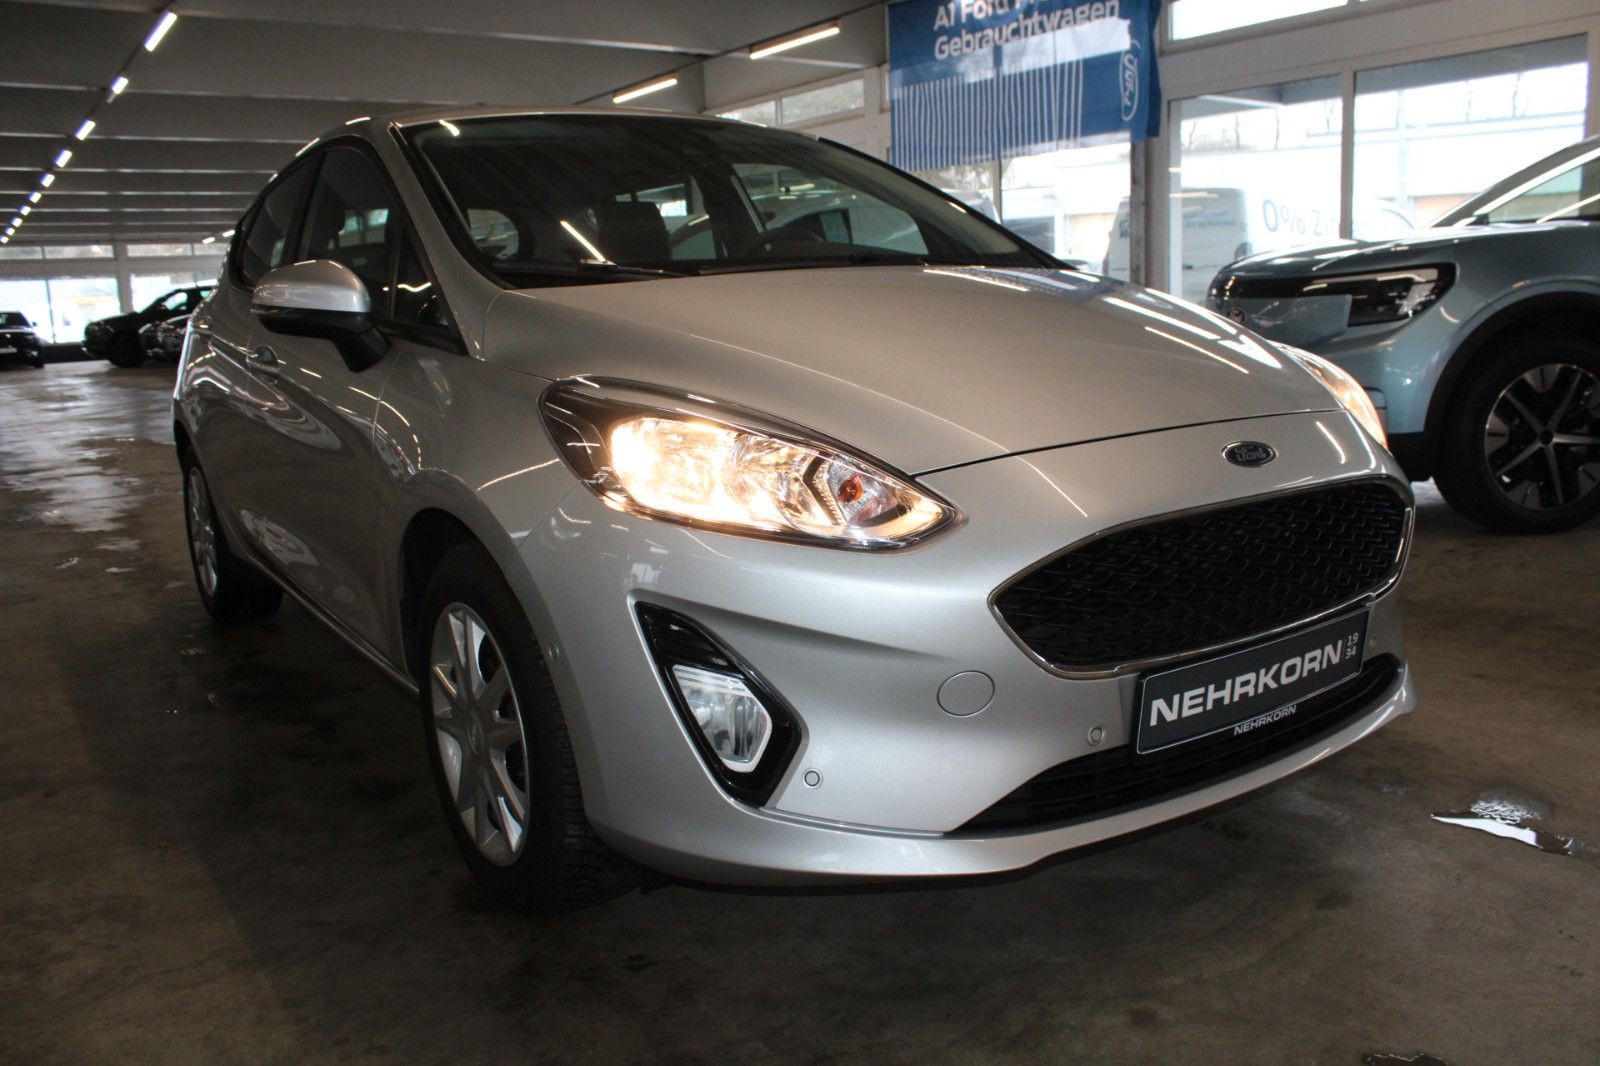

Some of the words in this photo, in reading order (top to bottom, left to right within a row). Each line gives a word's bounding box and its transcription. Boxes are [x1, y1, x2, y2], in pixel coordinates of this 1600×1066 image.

[961, 0, 1009, 23] Ford
[934, 0, 1119, 60] Gebrauchtwagen
[1262, 199, 1306, 235] 0%
[1346, 632, 1359, 646] 19
[1150, 640, 1343, 727] NEHRKORN
[1234, 704, 1297, 736] NEHRKORN
